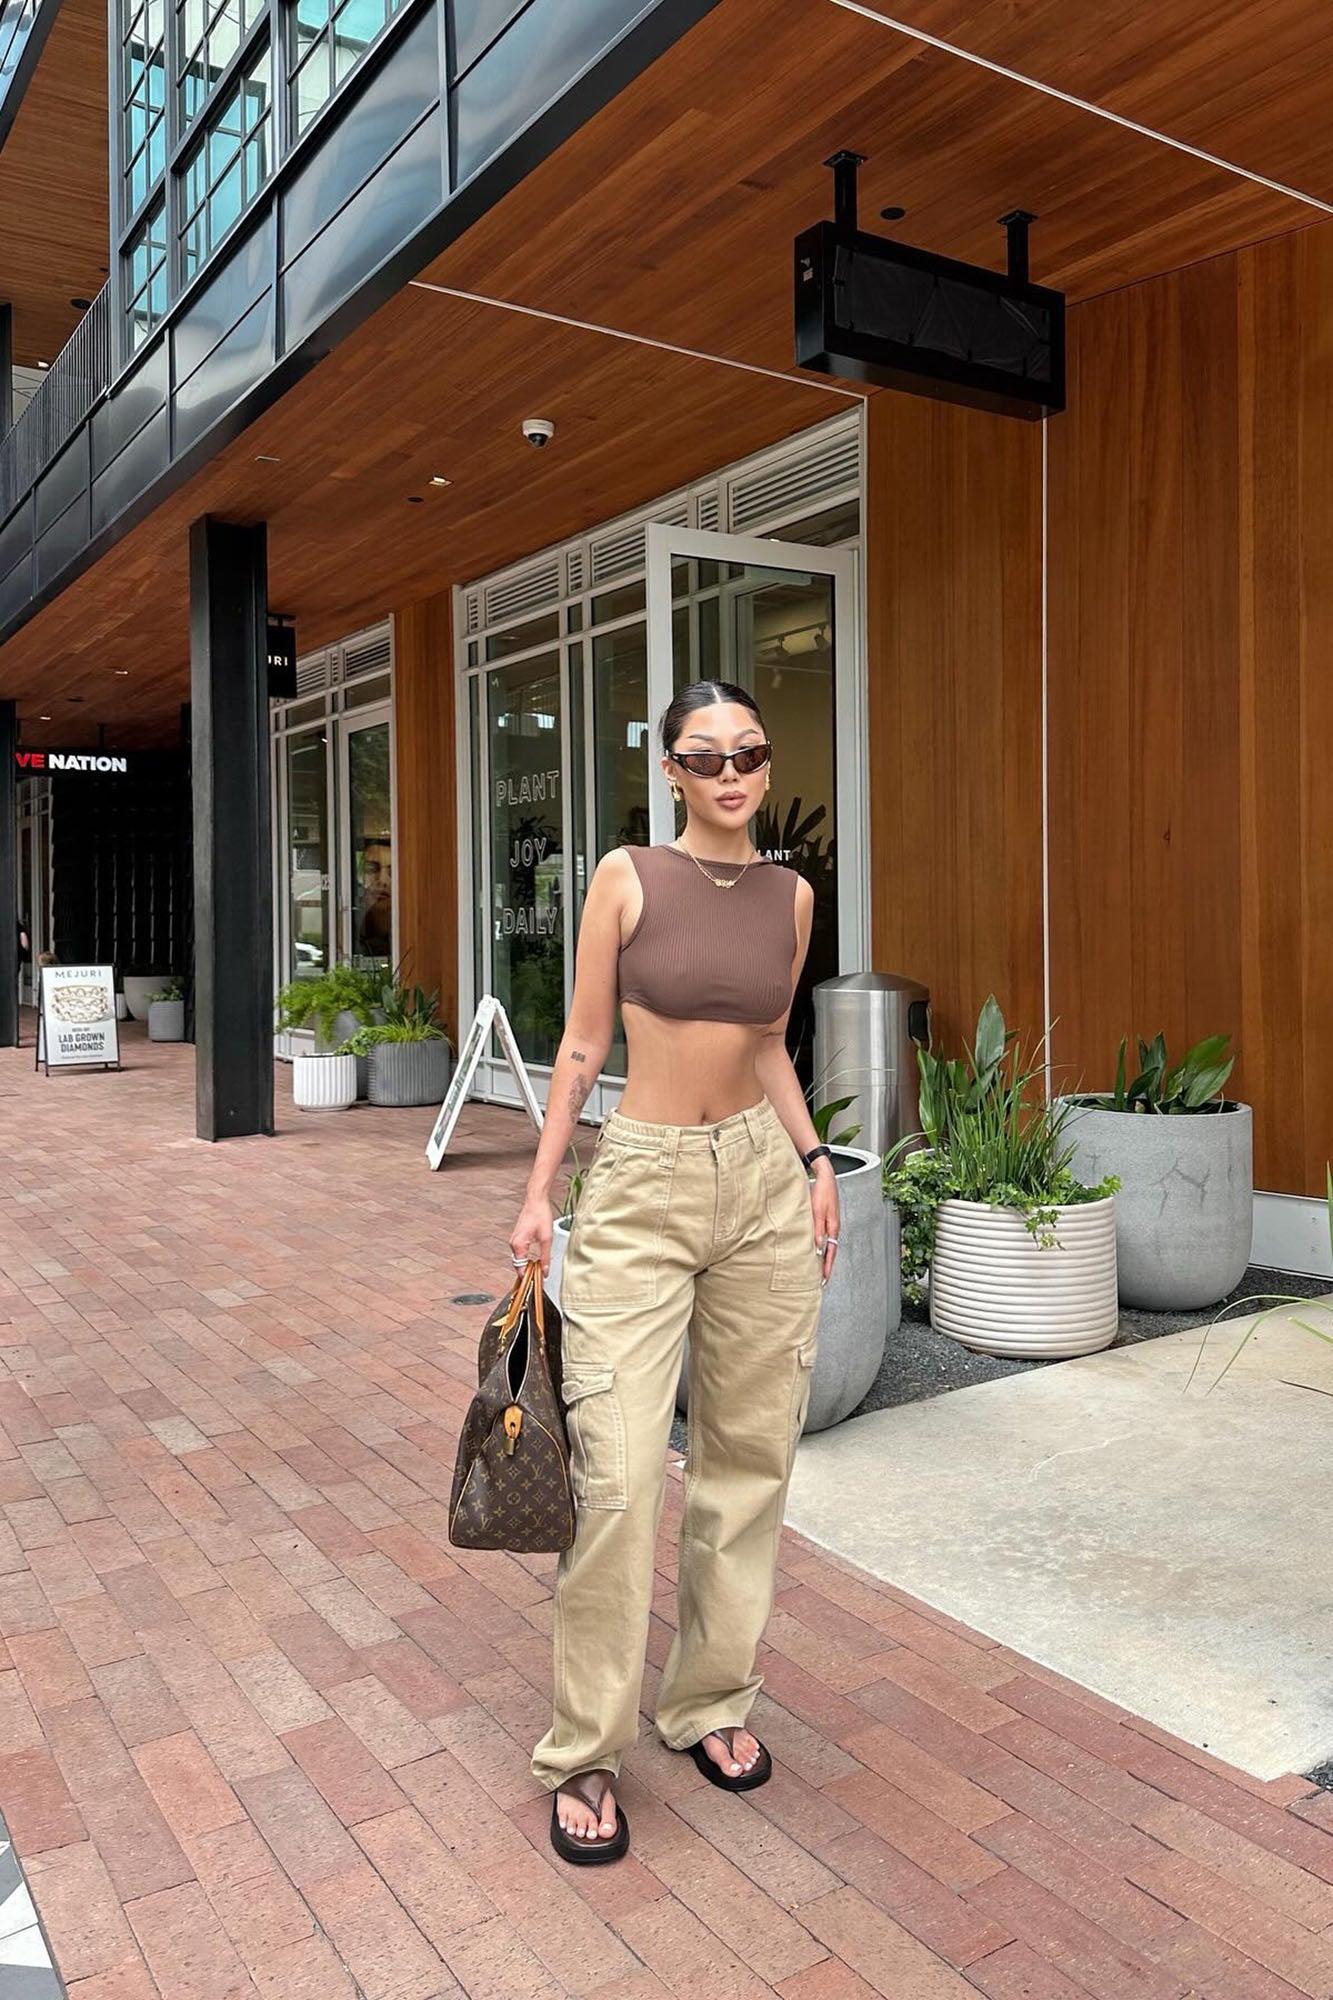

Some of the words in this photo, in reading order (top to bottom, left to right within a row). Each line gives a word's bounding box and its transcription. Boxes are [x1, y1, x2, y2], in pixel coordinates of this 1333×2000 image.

[48, 753, 128, 772] NATION
[496, 769, 560, 807] PLANT
[509, 837, 547, 868] JOY
[502, 906, 558, 935] DAILY
[55, 969, 102, 978] MEJURI
[58, 1033, 74, 1043] LAB
[75, 1032, 105, 1042] GROWN
[60, 1042, 105, 1053] DIAMONDS
